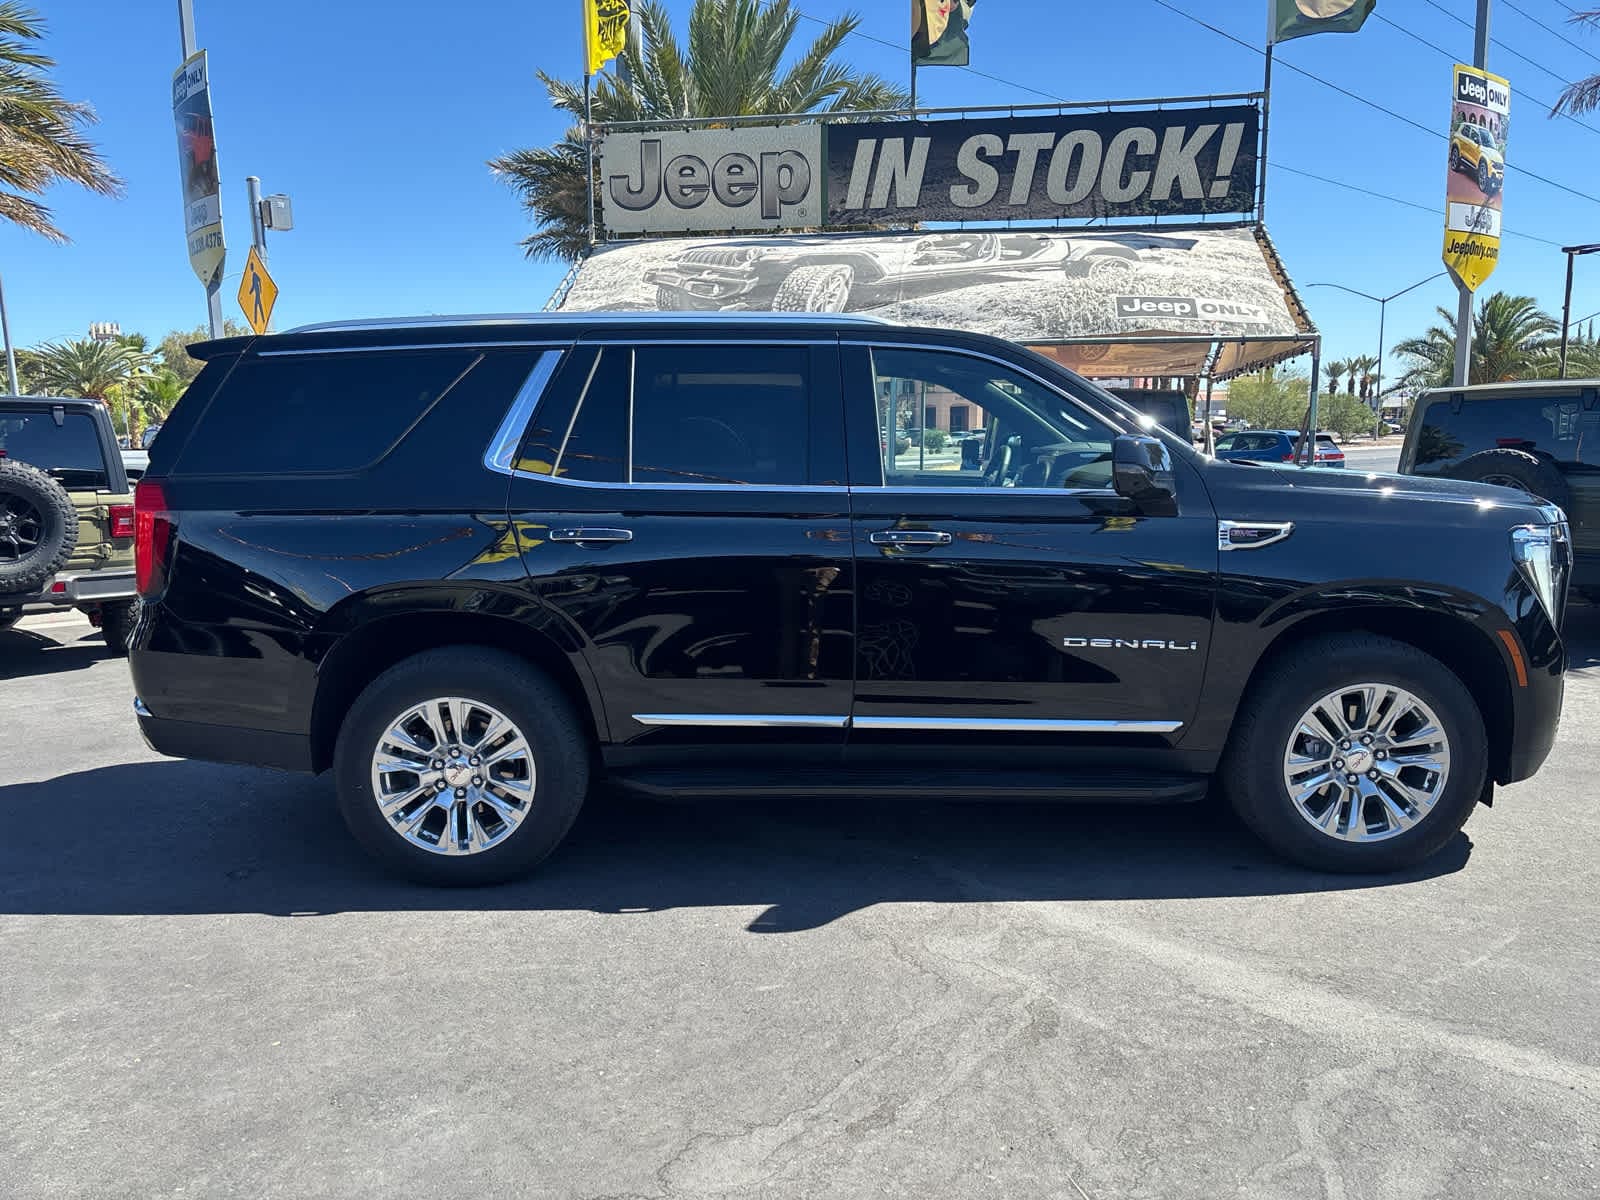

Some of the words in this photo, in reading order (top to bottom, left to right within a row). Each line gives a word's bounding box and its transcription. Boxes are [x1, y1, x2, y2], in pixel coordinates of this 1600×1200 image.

[187, 66, 204, 88] ONLY
[1460, 76, 1486, 103] Jeep
[1488, 88, 1508, 107] ONLY
[609, 138, 812, 220] Jeep
[845, 136, 931, 209] IN
[949, 122, 1245, 209] STOCK!
[1464, 205, 1493, 233] Jeep
[1447, 238, 1499, 260] JeepOnly.com
[1122, 298, 1192, 315] Jeep
[1200, 303, 1262, 316] ONLY
[1230, 529, 1258, 537] GMC
[1063, 637, 1197, 650] DENALI
